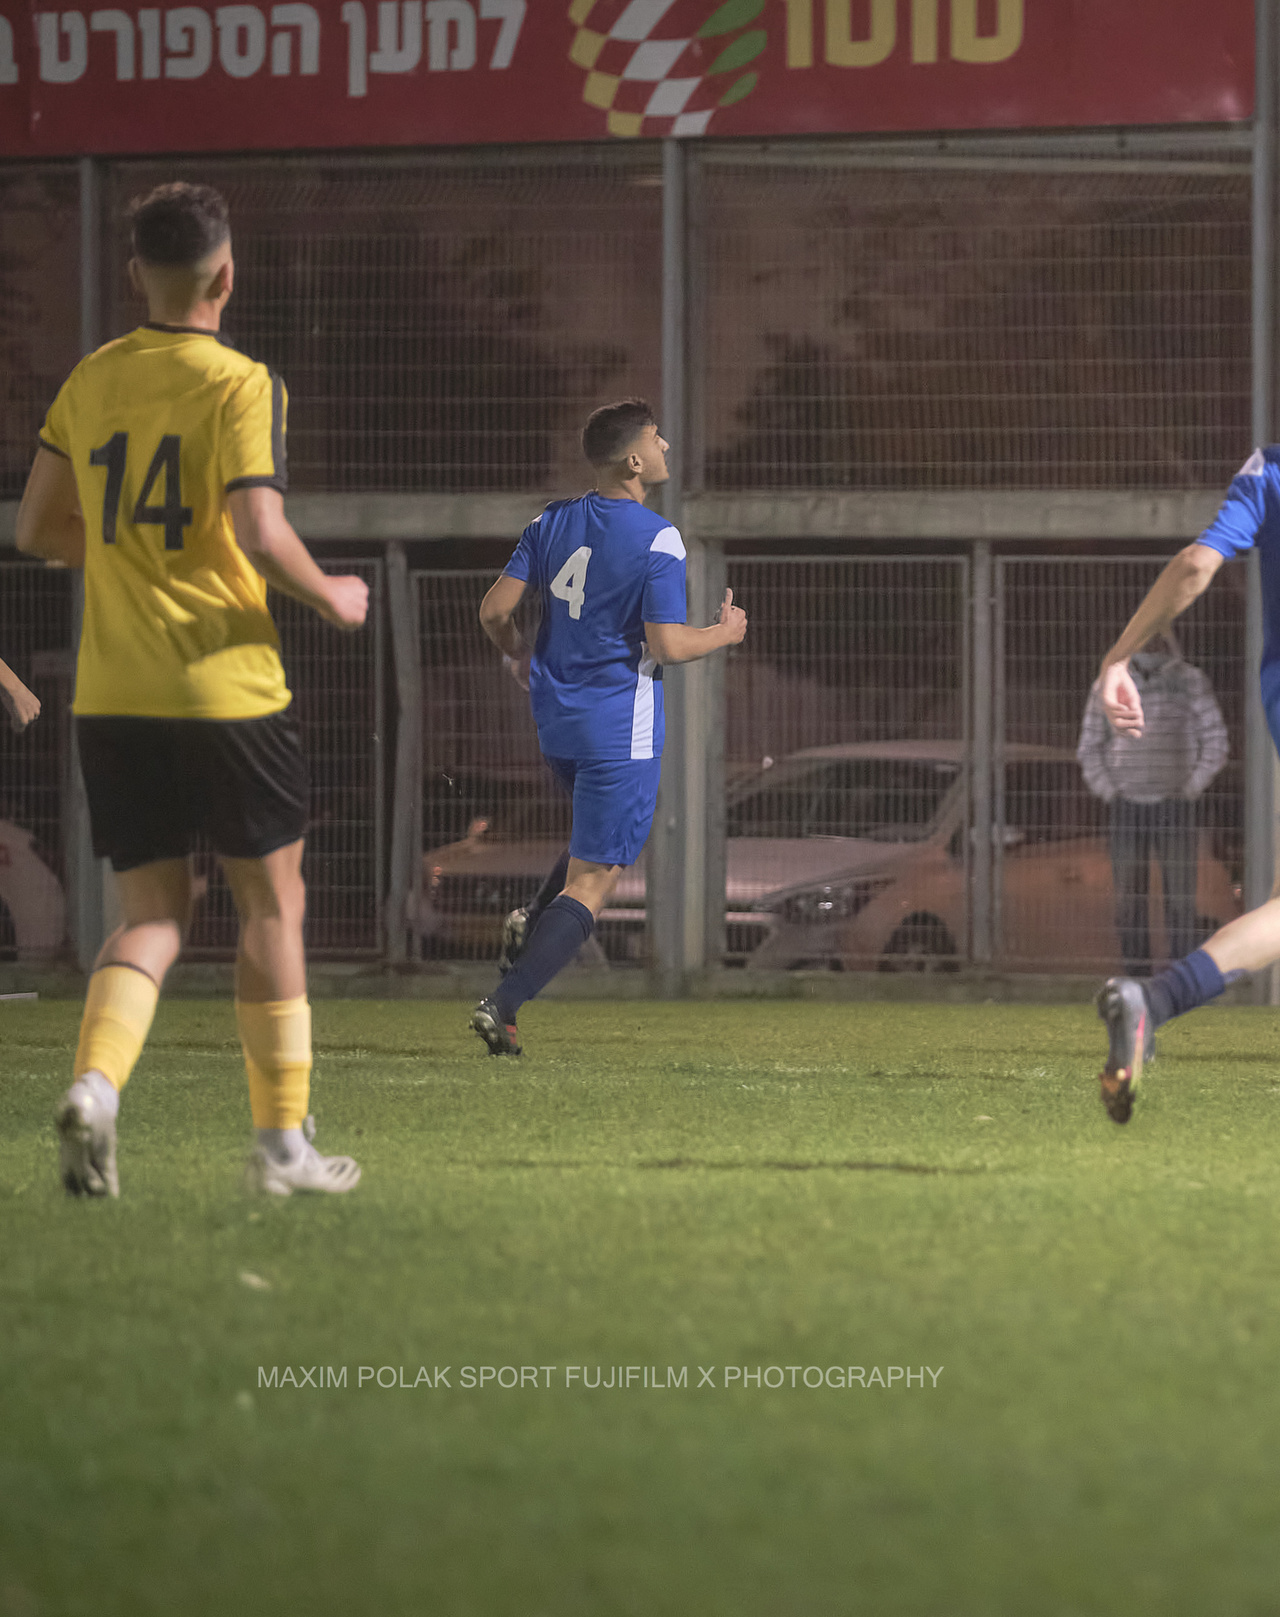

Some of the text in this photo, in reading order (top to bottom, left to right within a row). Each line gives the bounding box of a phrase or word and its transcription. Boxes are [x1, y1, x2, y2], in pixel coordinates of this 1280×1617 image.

[38, 3, 320, 84] הספורט
[341, 0, 527, 97] למען
[89, 431, 193, 550] 14
[550, 546, 592, 620] 4
